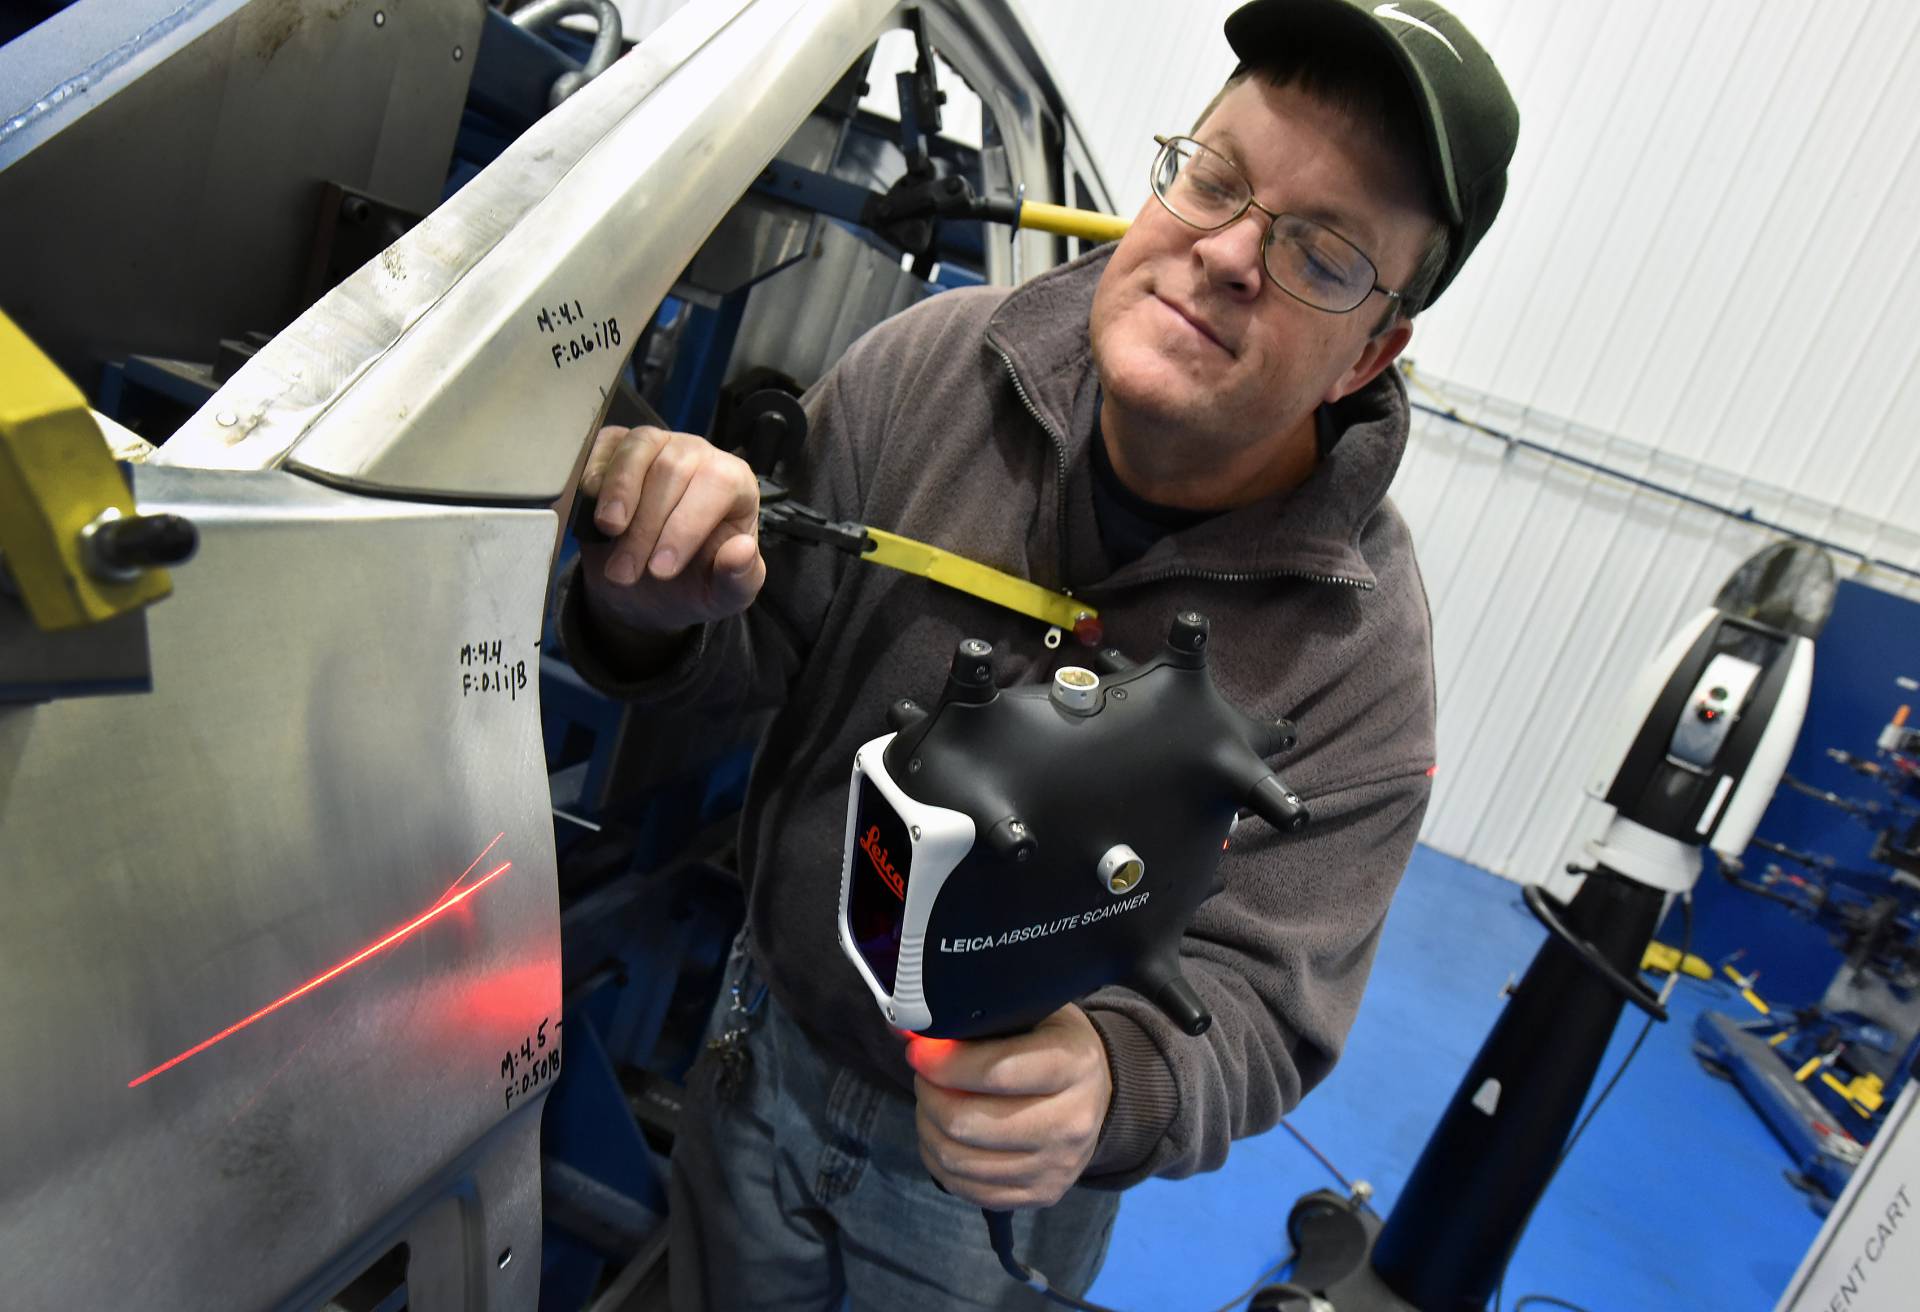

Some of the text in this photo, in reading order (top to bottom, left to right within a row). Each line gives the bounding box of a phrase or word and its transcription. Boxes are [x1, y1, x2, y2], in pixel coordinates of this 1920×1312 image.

[537, 300, 584, 333] M:4.1
[461, 640, 502, 666] M:4.4
[860, 825, 904, 901] Leica
[940, 892, 1150, 953] LEICA ABSOLUTE SCANNER
[1824, 1185, 1911, 1312] ENT CART
